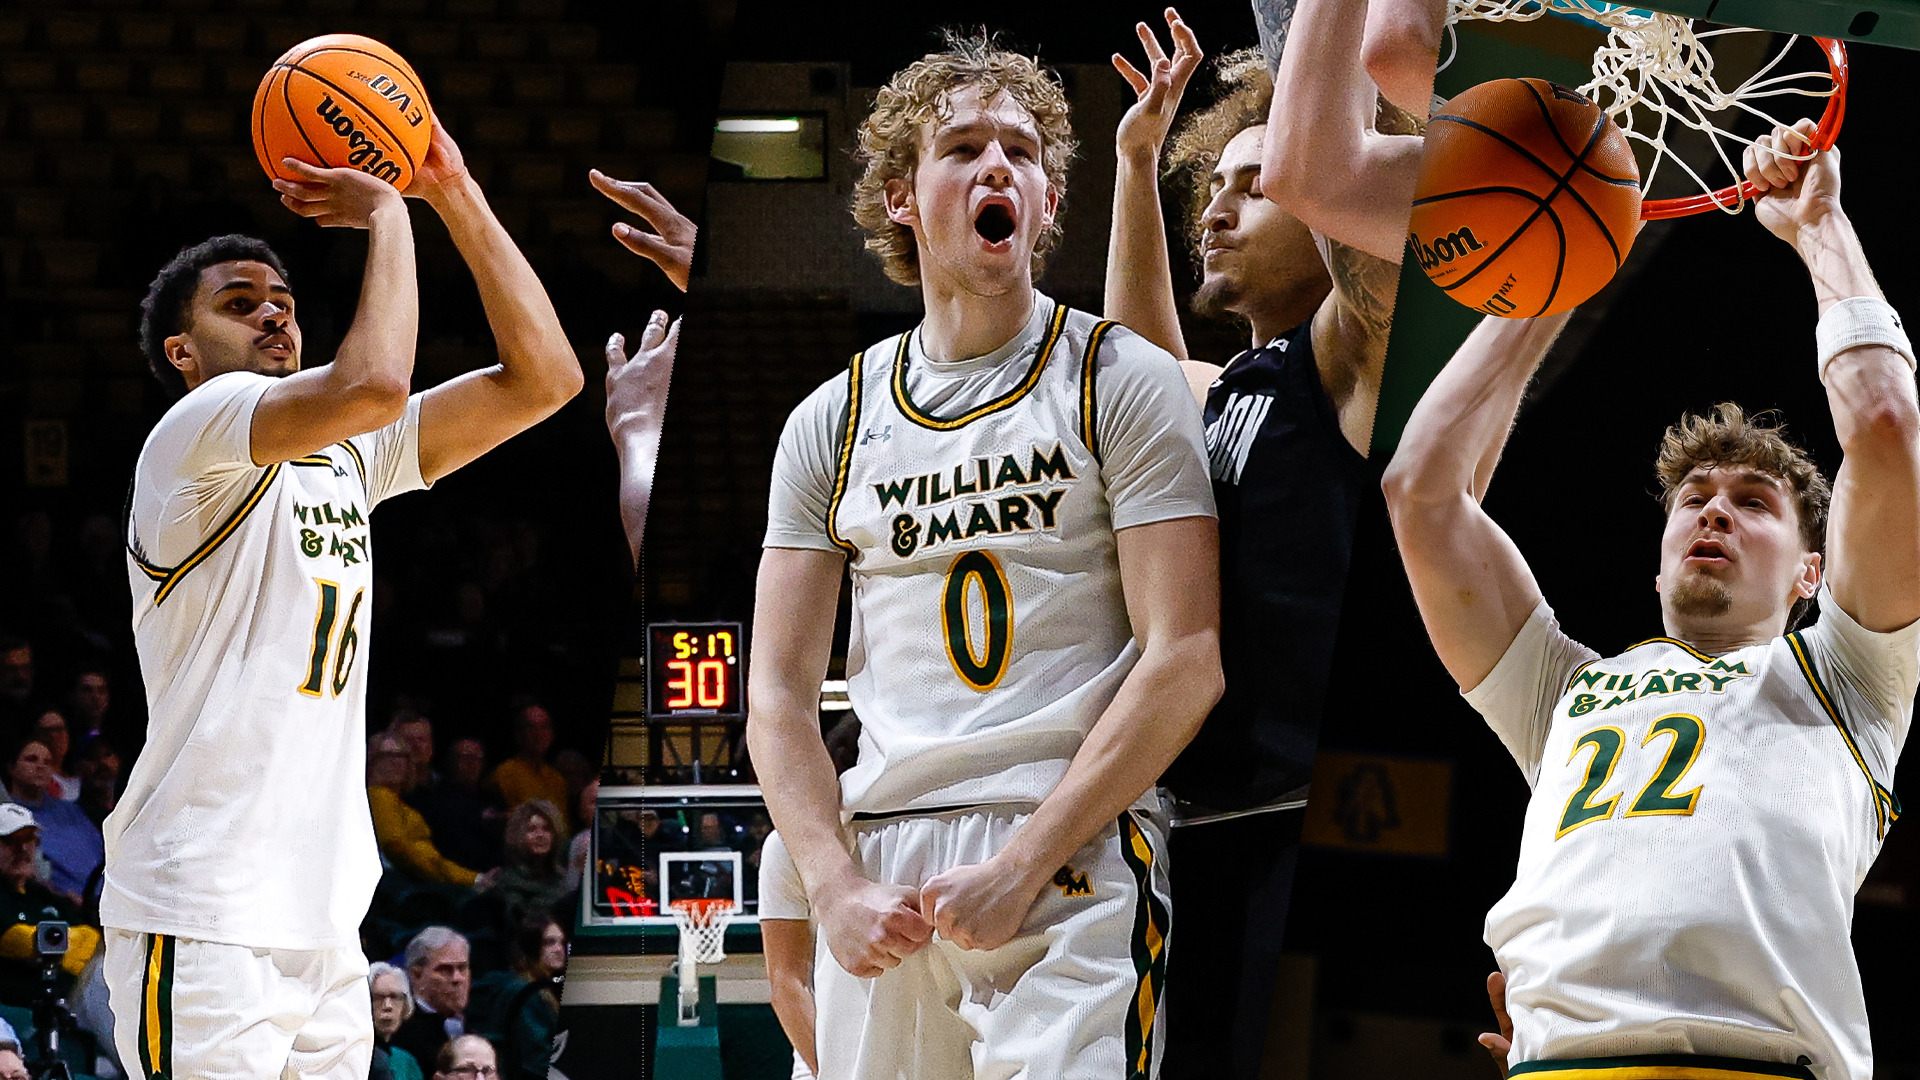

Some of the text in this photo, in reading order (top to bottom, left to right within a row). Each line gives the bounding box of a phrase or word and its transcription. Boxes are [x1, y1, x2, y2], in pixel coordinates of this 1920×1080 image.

[368, 74, 424, 128] EVO
[316, 95, 402, 185] Wilson
[1407, 225, 1484, 271] lson
[1498, 272, 1518, 296] NXT
[870, 441, 1079, 512] WILLIAM
[300, 527, 325, 558] &
[891, 487, 1070, 558] & MARY
[297, 577, 365, 700] 16
[673, 631, 732, 660] 5:17
[940, 548, 1014, 693] 0
[665, 659, 725, 708] 30
[1567, 693, 1603, 718] &
[1554, 712, 1707, 842] 22
